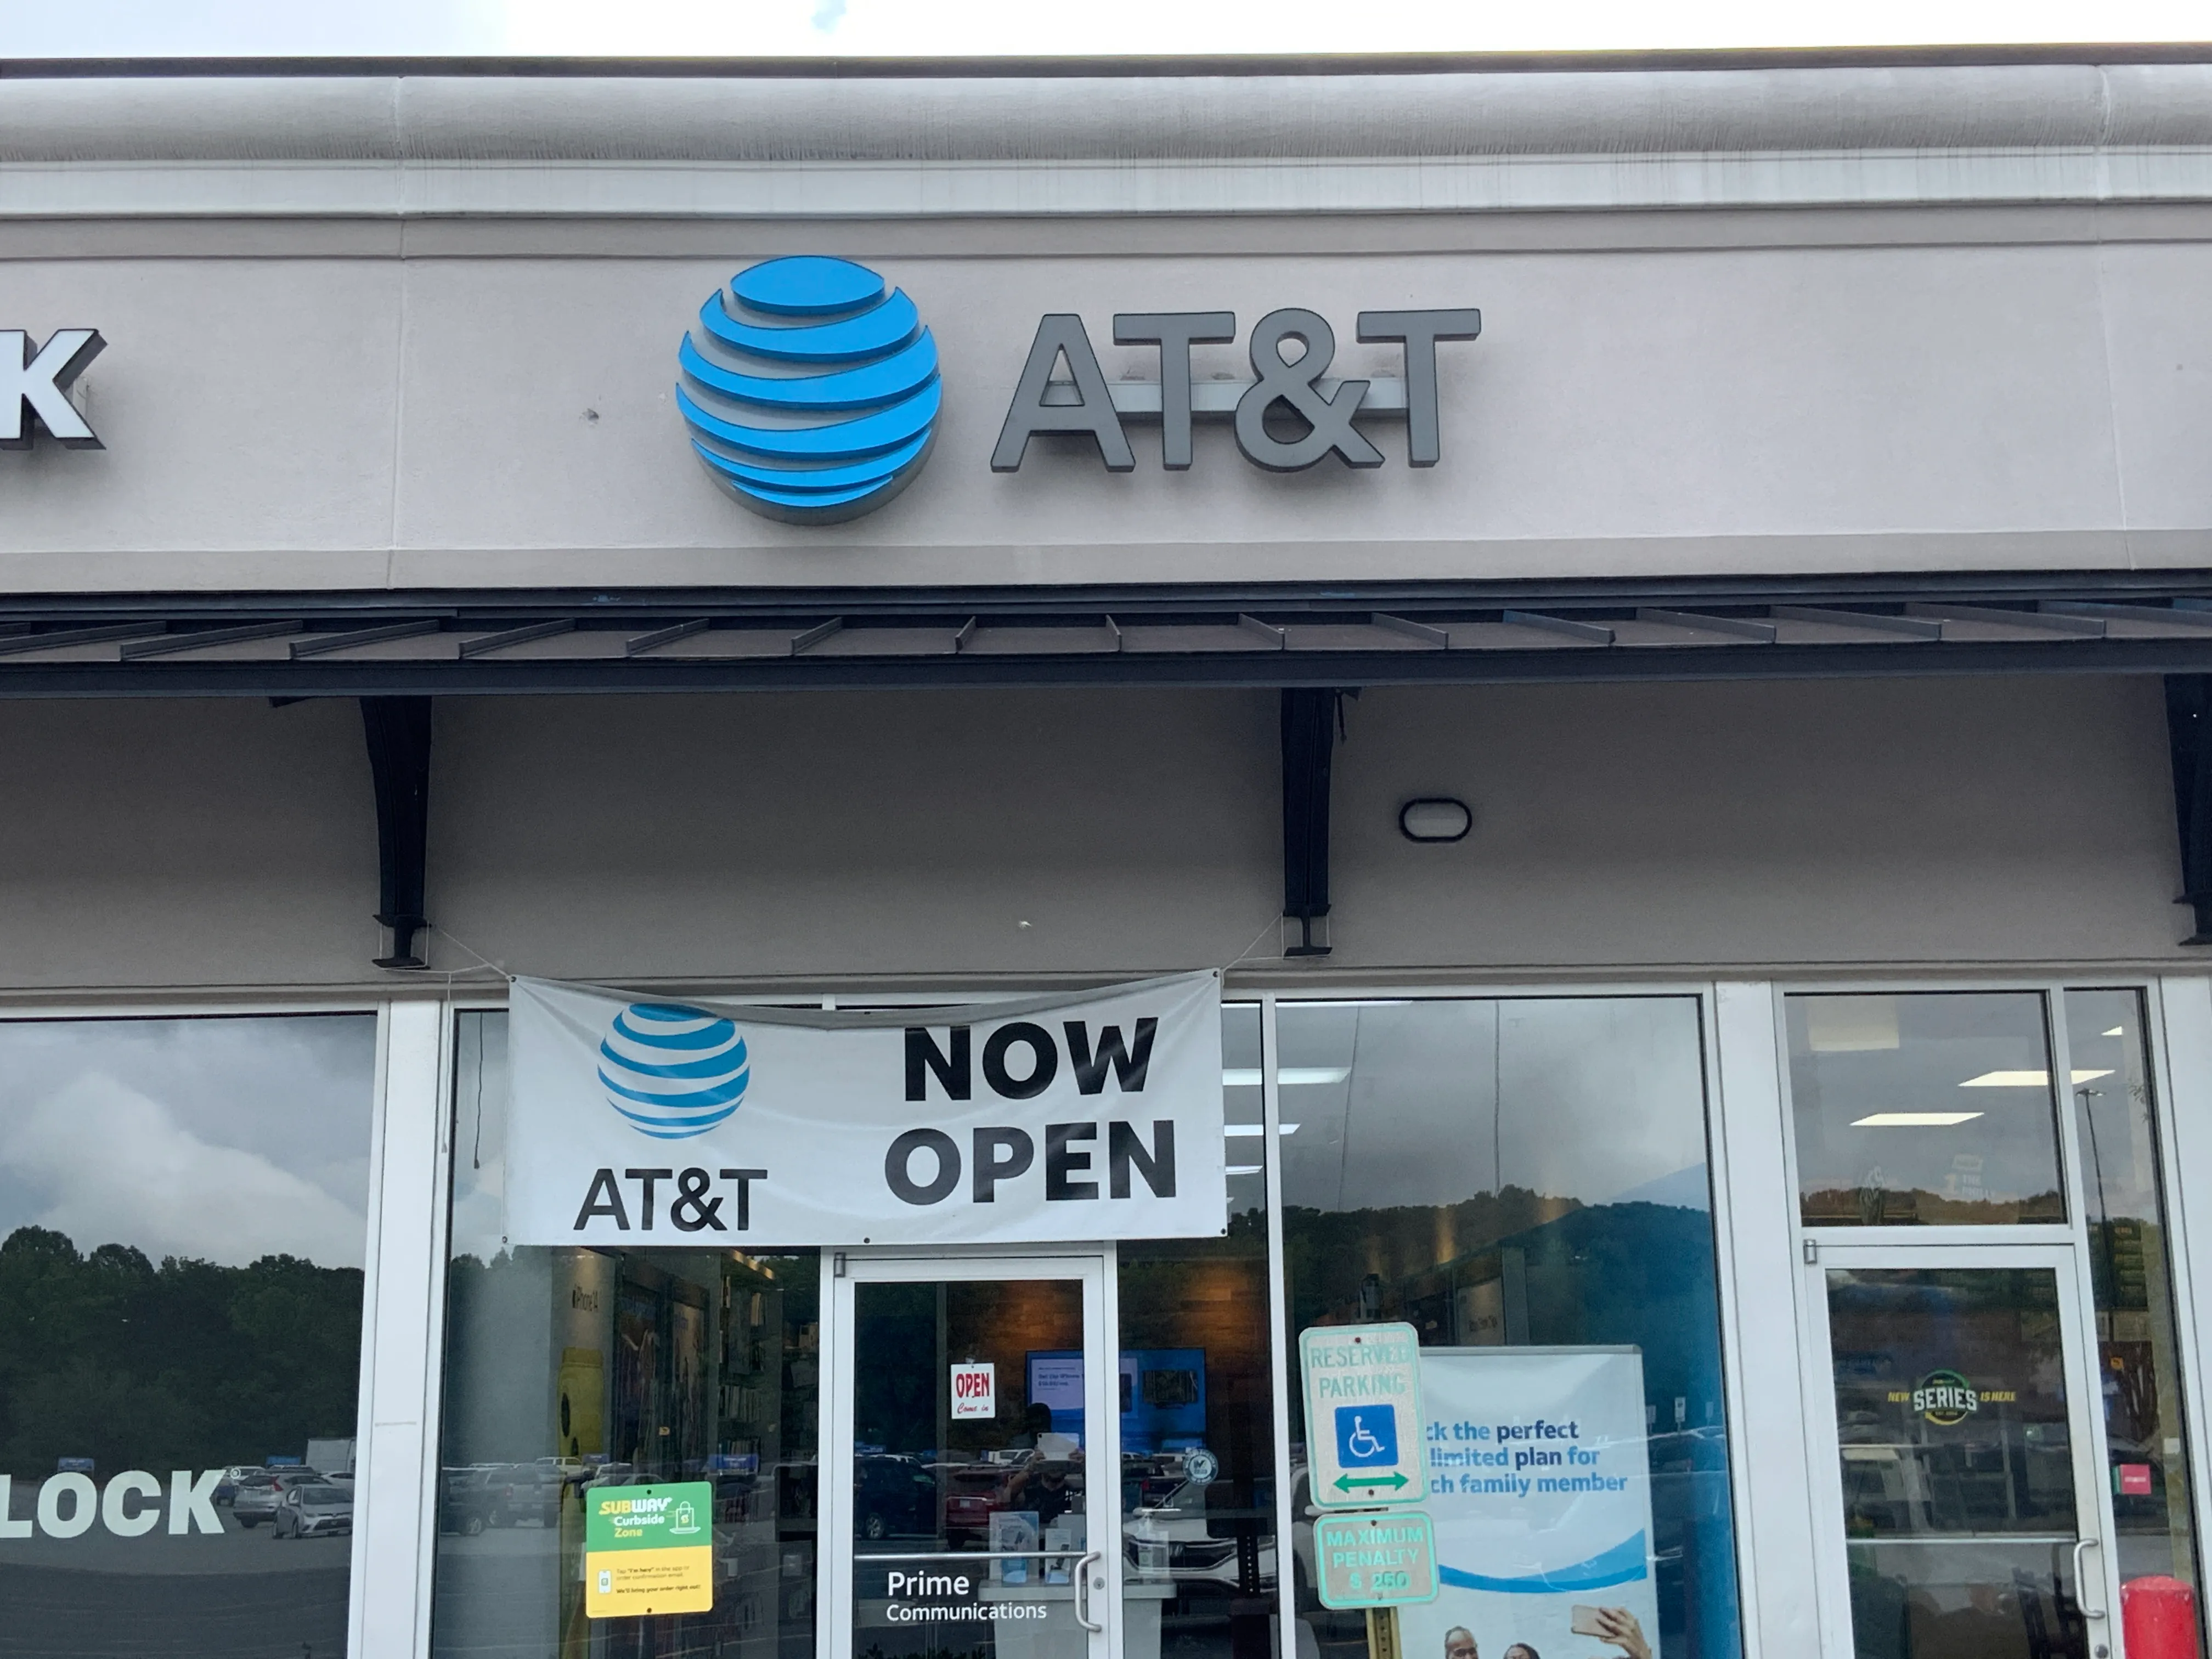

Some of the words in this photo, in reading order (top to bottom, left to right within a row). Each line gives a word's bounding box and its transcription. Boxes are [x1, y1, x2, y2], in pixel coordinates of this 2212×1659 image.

[0, 329, 107, 450] K
[990, 308, 1481, 473] AT&T
[905, 1017, 1158, 1101] NOW
[885, 1120, 1176, 1205] OPEN
[573, 1167, 768, 1232] AT&T
[1311, 1342, 1410, 1368] RESERVED
[956, 1373, 990, 1398] OPEN
[1319, 1373, 1406, 1398] PARKING
[957, 1402, 977, 1414] Come
[1888, 1391, 1910, 1402] NEW
[1914, 1386, 1977, 1412] SERIES
[1453, 1421, 1490, 1440] the
[1497, 1420, 1579, 1444] perfect
[1430, 1447, 1509, 1467] limited
[1515, 1447, 1562, 1471] plan
[1567, 1446, 1600, 1465] for
[1460, 1472, 1531, 1498] family
[1537, 1472, 1628, 1492] member
[599, 1497, 673, 1515] SUBWAY
[614, 1515, 665, 1526] Curbside
[614, 1528, 642, 1538] Zone
[1327, 1527, 1423, 1547] MAXIMUM
[1333, 1549, 1419, 1568] PENALTY
[888, 1570, 969, 1596] Prime
[1371, 1571, 1410, 1591] 250
[887, 1602, 1047, 1621] Communications
